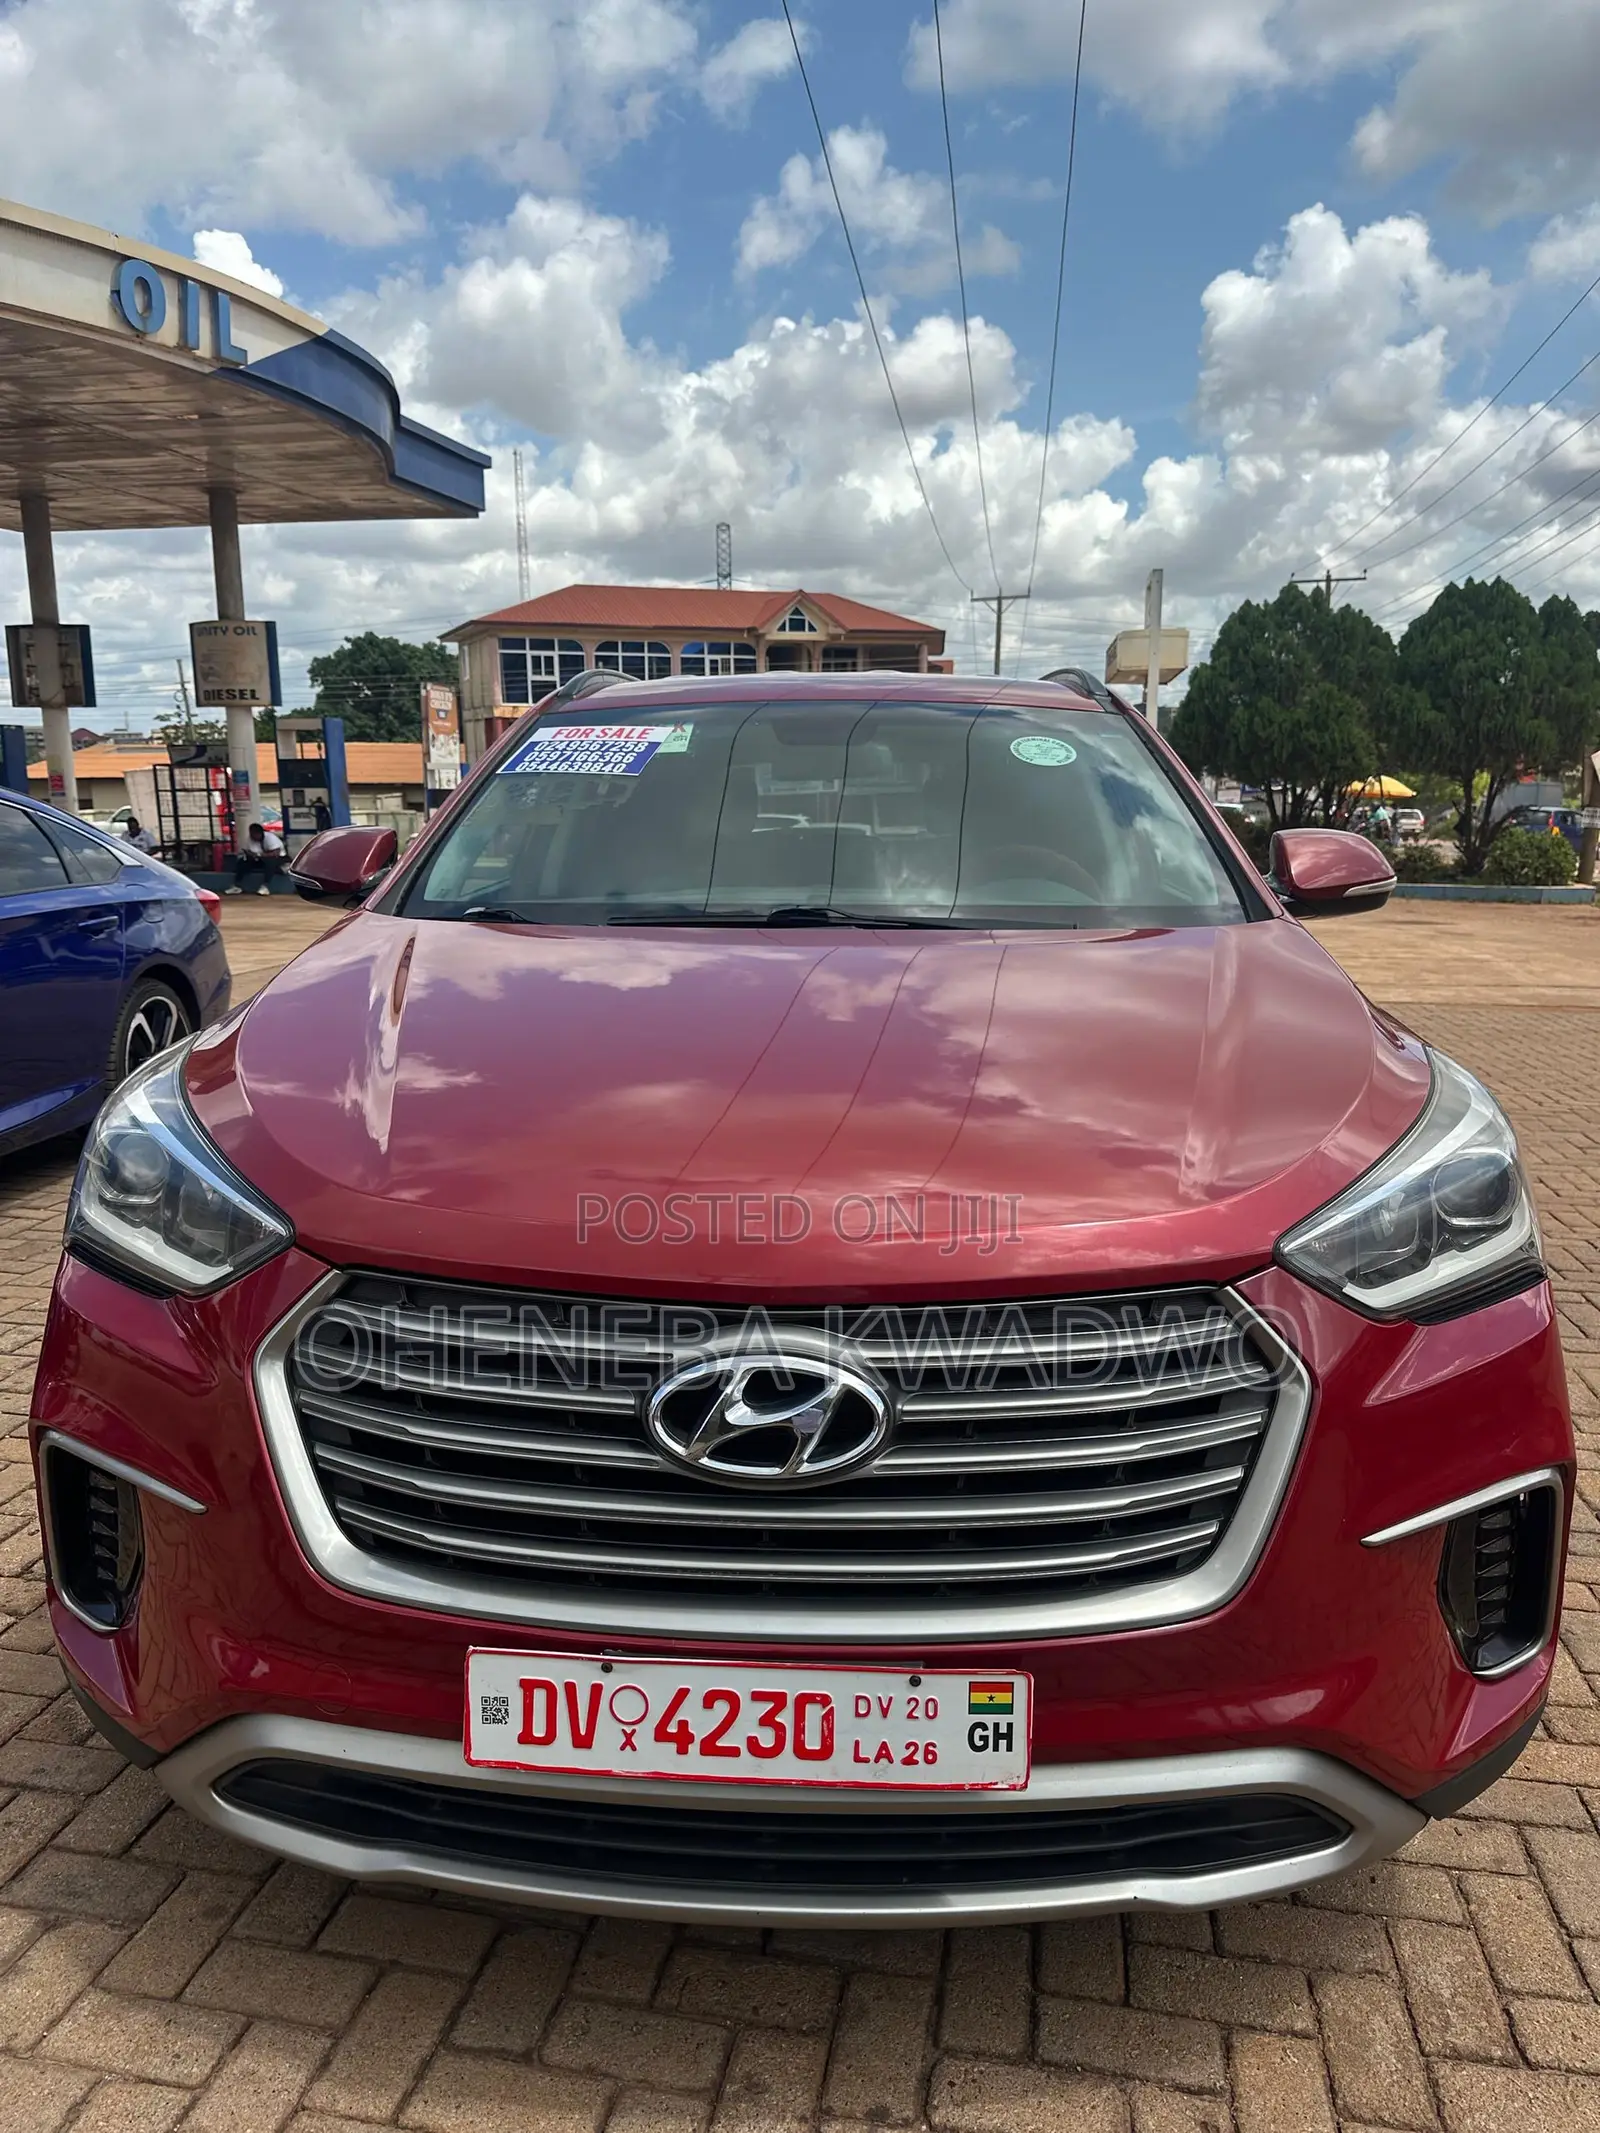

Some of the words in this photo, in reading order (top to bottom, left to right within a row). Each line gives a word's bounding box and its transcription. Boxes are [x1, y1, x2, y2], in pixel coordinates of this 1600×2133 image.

[112, 259, 248, 366] OIL
[233, 625, 258, 636] OIL
[203, 688, 260, 701] DIESEL
[551, 728, 595, 740] FOR
[596, 728, 654, 740] SALE
[534, 741, 649, 752] 0249567258
[523, 751, 638, 763] 0597166366
[514, 761, 627, 773] 0544639840
[854, 1694, 894, 1719] DV
[906, 1696, 940, 1720] 20
[517, 1677, 604, 1749] DV
[653, 1686, 836, 1761] 4230
[967, 1721, 1014, 1753] GH
[852, 1738, 895, 1764] LA
[900, 1740, 939, 1766] 26
